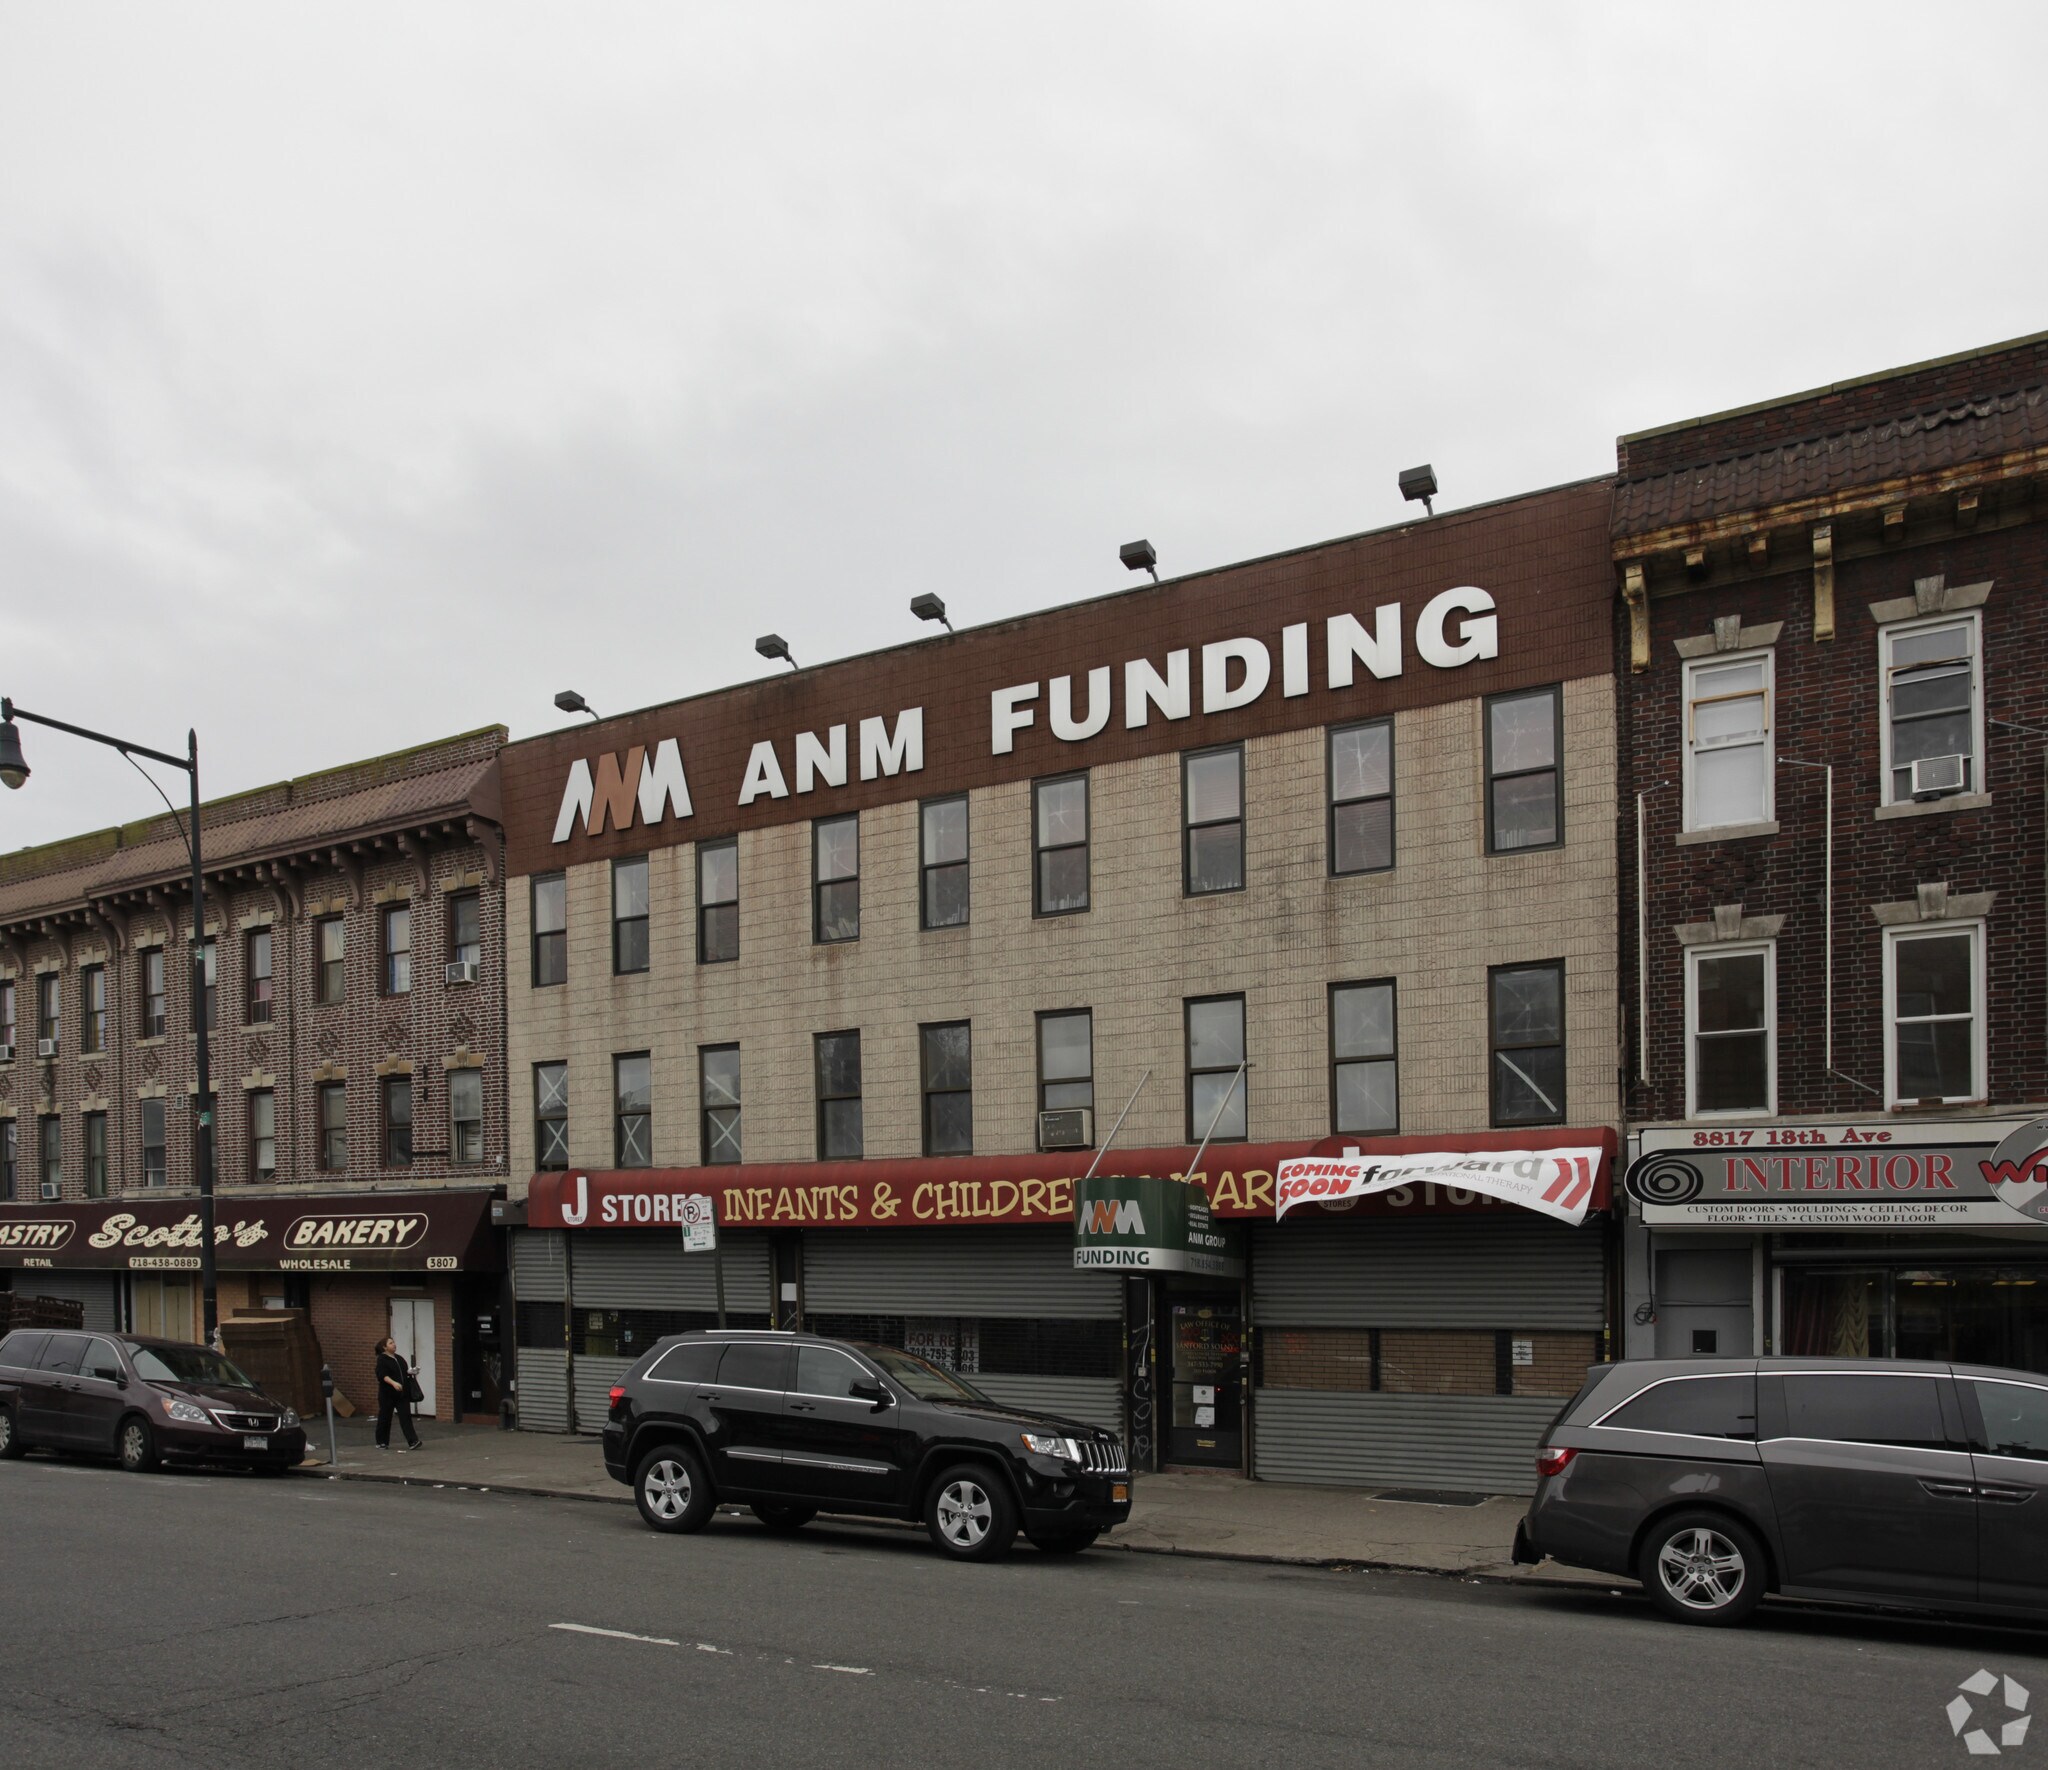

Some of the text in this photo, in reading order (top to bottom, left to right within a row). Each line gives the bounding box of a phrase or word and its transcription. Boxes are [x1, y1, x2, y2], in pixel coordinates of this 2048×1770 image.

[737, 706, 924, 806] ANM
[990, 585, 1499, 756] FUNDING
[1839, 1127, 1893, 1143] Ave
[1280, 1163, 1361, 1181] COMING
[1722, 1153, 1959, 1192] INTERIOR
[1485, 1176, 1534, 1193] THERAPY
[561, 1176, 704, 1225] J STORE
[723, 1186, 858, 1221] INFANTS
[870, 1181, 902, 1219] &
[1279, 1178, 1352, 1208] SOON
[1687, 1204, 1968, 1214] CUSTOM DOORS MOULDINGS CEILING DECOR
[1708, 1214, 1936, 1223] FLOOR TILES CUSTOM WOOD FLOOR
[88, 1213, 269, 1248] Scotto's
[293, 1218, 418, 1245] BAKERY
[1188, 1232, 1226, 1248] ANM GROUP
[23, 1258, 53, 1267] RETAIL
[131, 1258, 199, 1267] 718-438-0889
[280, 1259, 351, 1269] WHOLESALE
[430, 1257, 454, 1268] 3807
[1076, 1249, 1150, 1265] FUNDING
[908, 1332, 934, 1346] FOR
